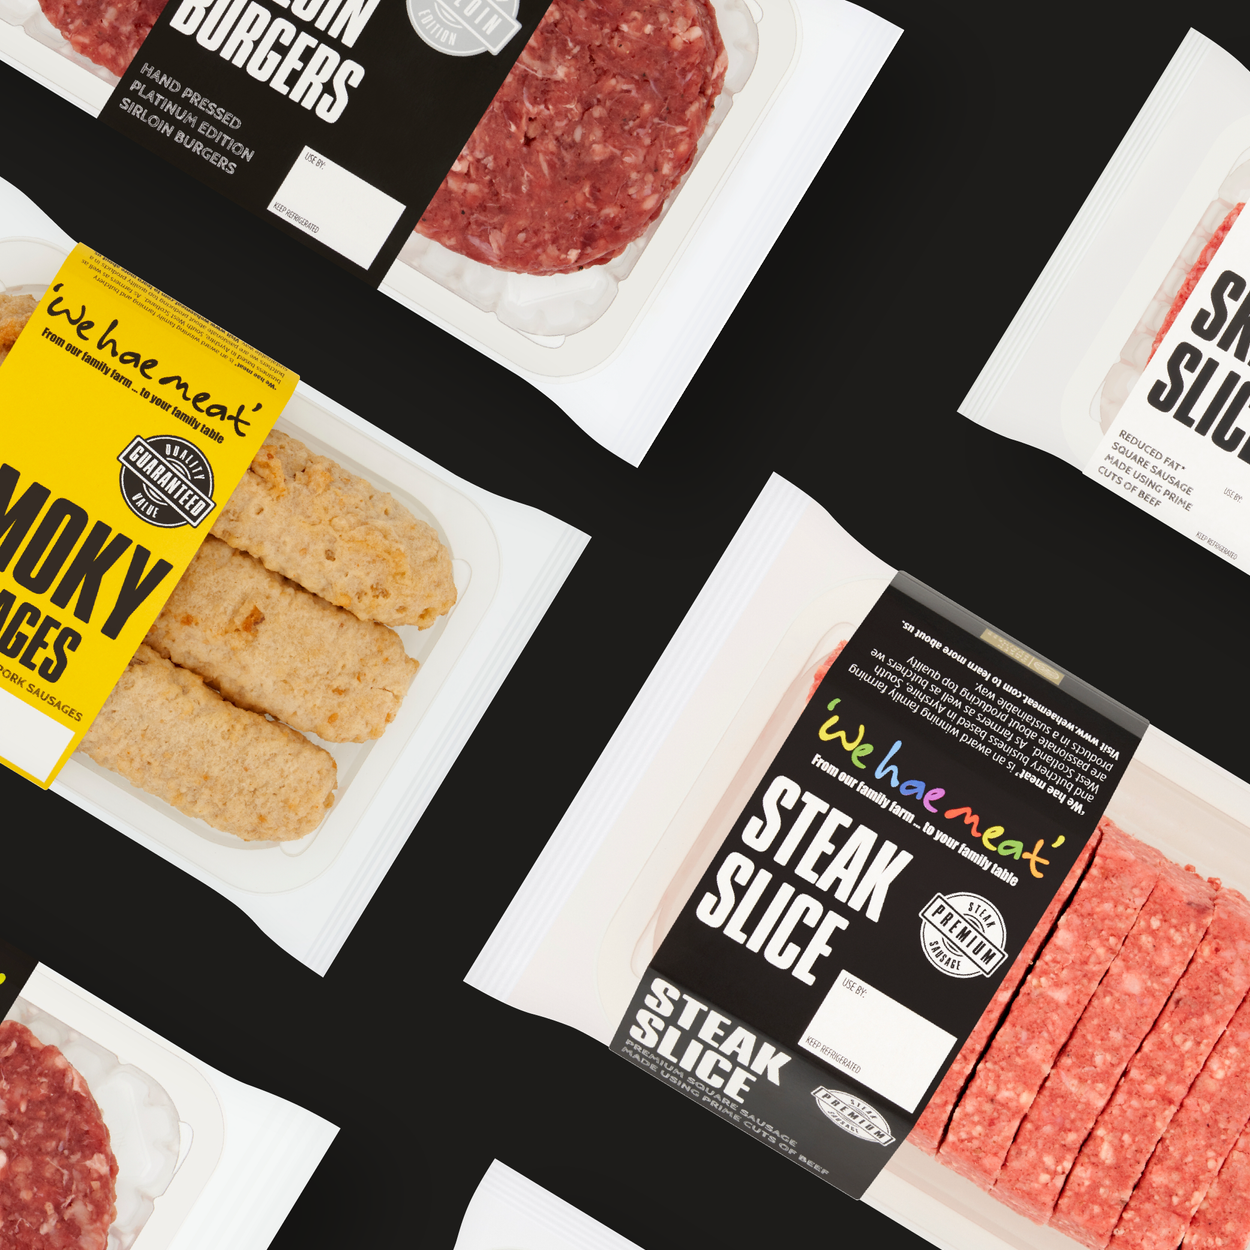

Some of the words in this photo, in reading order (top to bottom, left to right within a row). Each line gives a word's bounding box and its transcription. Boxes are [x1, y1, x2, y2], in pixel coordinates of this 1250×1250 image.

[417, 9, 457, 46] EDITION
[169, 0, 366, 124] BURGERS
[129, 79, 198, 129] PLATINUM
[197, 120, 255, 162] EDITION
[139, 62, 182, 93] HAND
[180, 87, 242, 130] PRESSED
[119, 97, 175, 137] SIRLOIN
[173, 129, 238, 175] BURGERS
[96, 319, 159, 380] hae
[165, 443, 205, 480] QUALITY
[1118, 429, 1163, 460] REDUCED
[128, 445, 206, 517] GUARANTEED
[131, 492, 159, 518] VALUE
[0, 462, 174, 641] MOKY
[901, 620, 915, 633] us.
[914, 629, 943, 650] about
[942, 646, 967, 665] more
[967, 661, 992, 681] learn
[991, 676, 1002, 688] to
[25, 683, 83, 722] SAUSAGES
[1002, 682, 1100, 747] www.wehaemeat.com
[874, 740, 946, 814] hae
[1099, 742, 1120, 761] Visit
[741, 775, 914, 923] STEAK
[695, 851, 850, 987] SLICE
[931, 904, 997, 965] PREMIUM
[968, 901, 996, 928] STEAK
[928, 940, 961, 971] SAUSAGE
[629, 1008, 757, 1104] SLICE
[644, 977, 792, 1087] STEAK
[821, 1093, 885, 1139] PREMIUM
